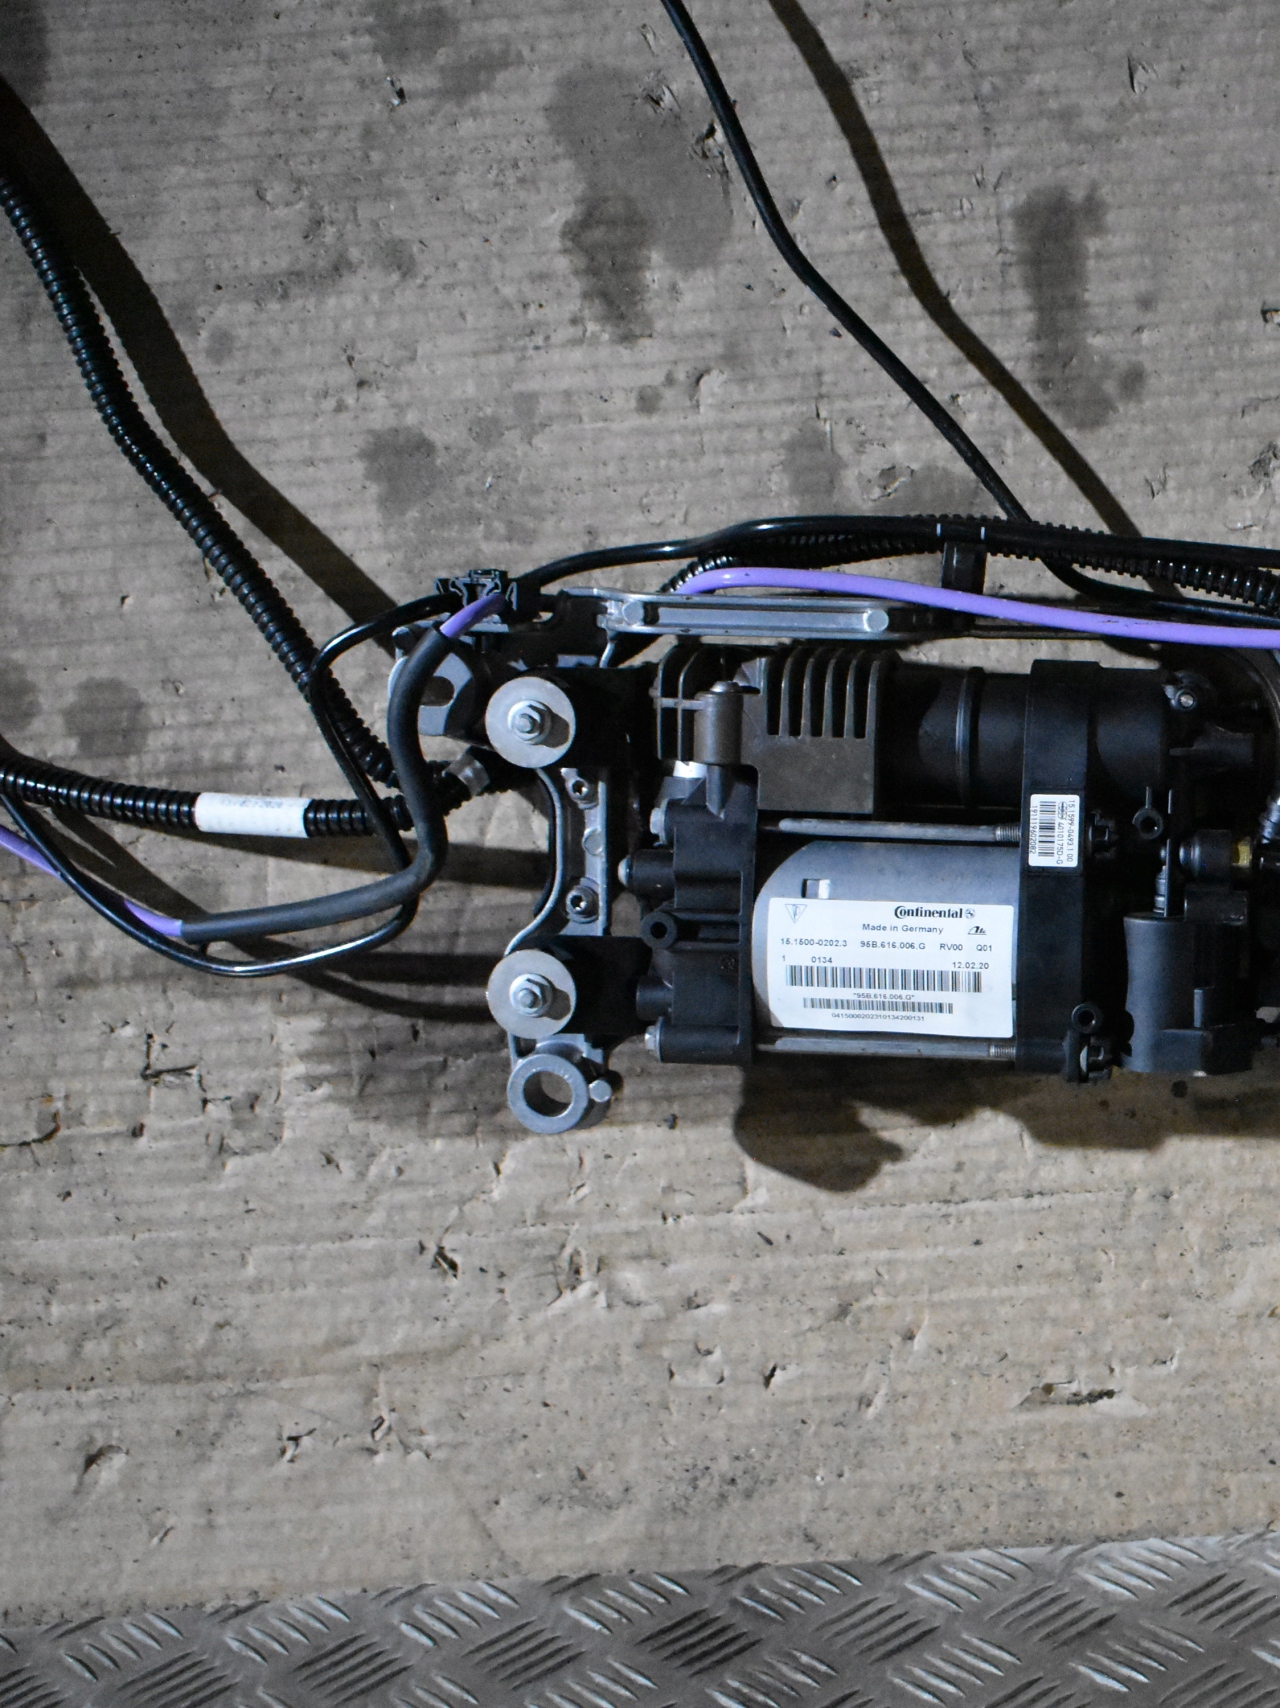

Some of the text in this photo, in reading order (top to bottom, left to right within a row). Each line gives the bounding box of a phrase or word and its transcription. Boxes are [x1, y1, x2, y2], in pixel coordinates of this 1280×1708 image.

[894, 905, 963, 920] Continental
[862, 923, 944, 935] Made in Germany
[780, 937, 993, 952] 15.1500-0202.3 95B.616.006.G RV00 Q01
[811, 955, 833, 964] 0134
[952, 961, 989, 970] 12.02.20
